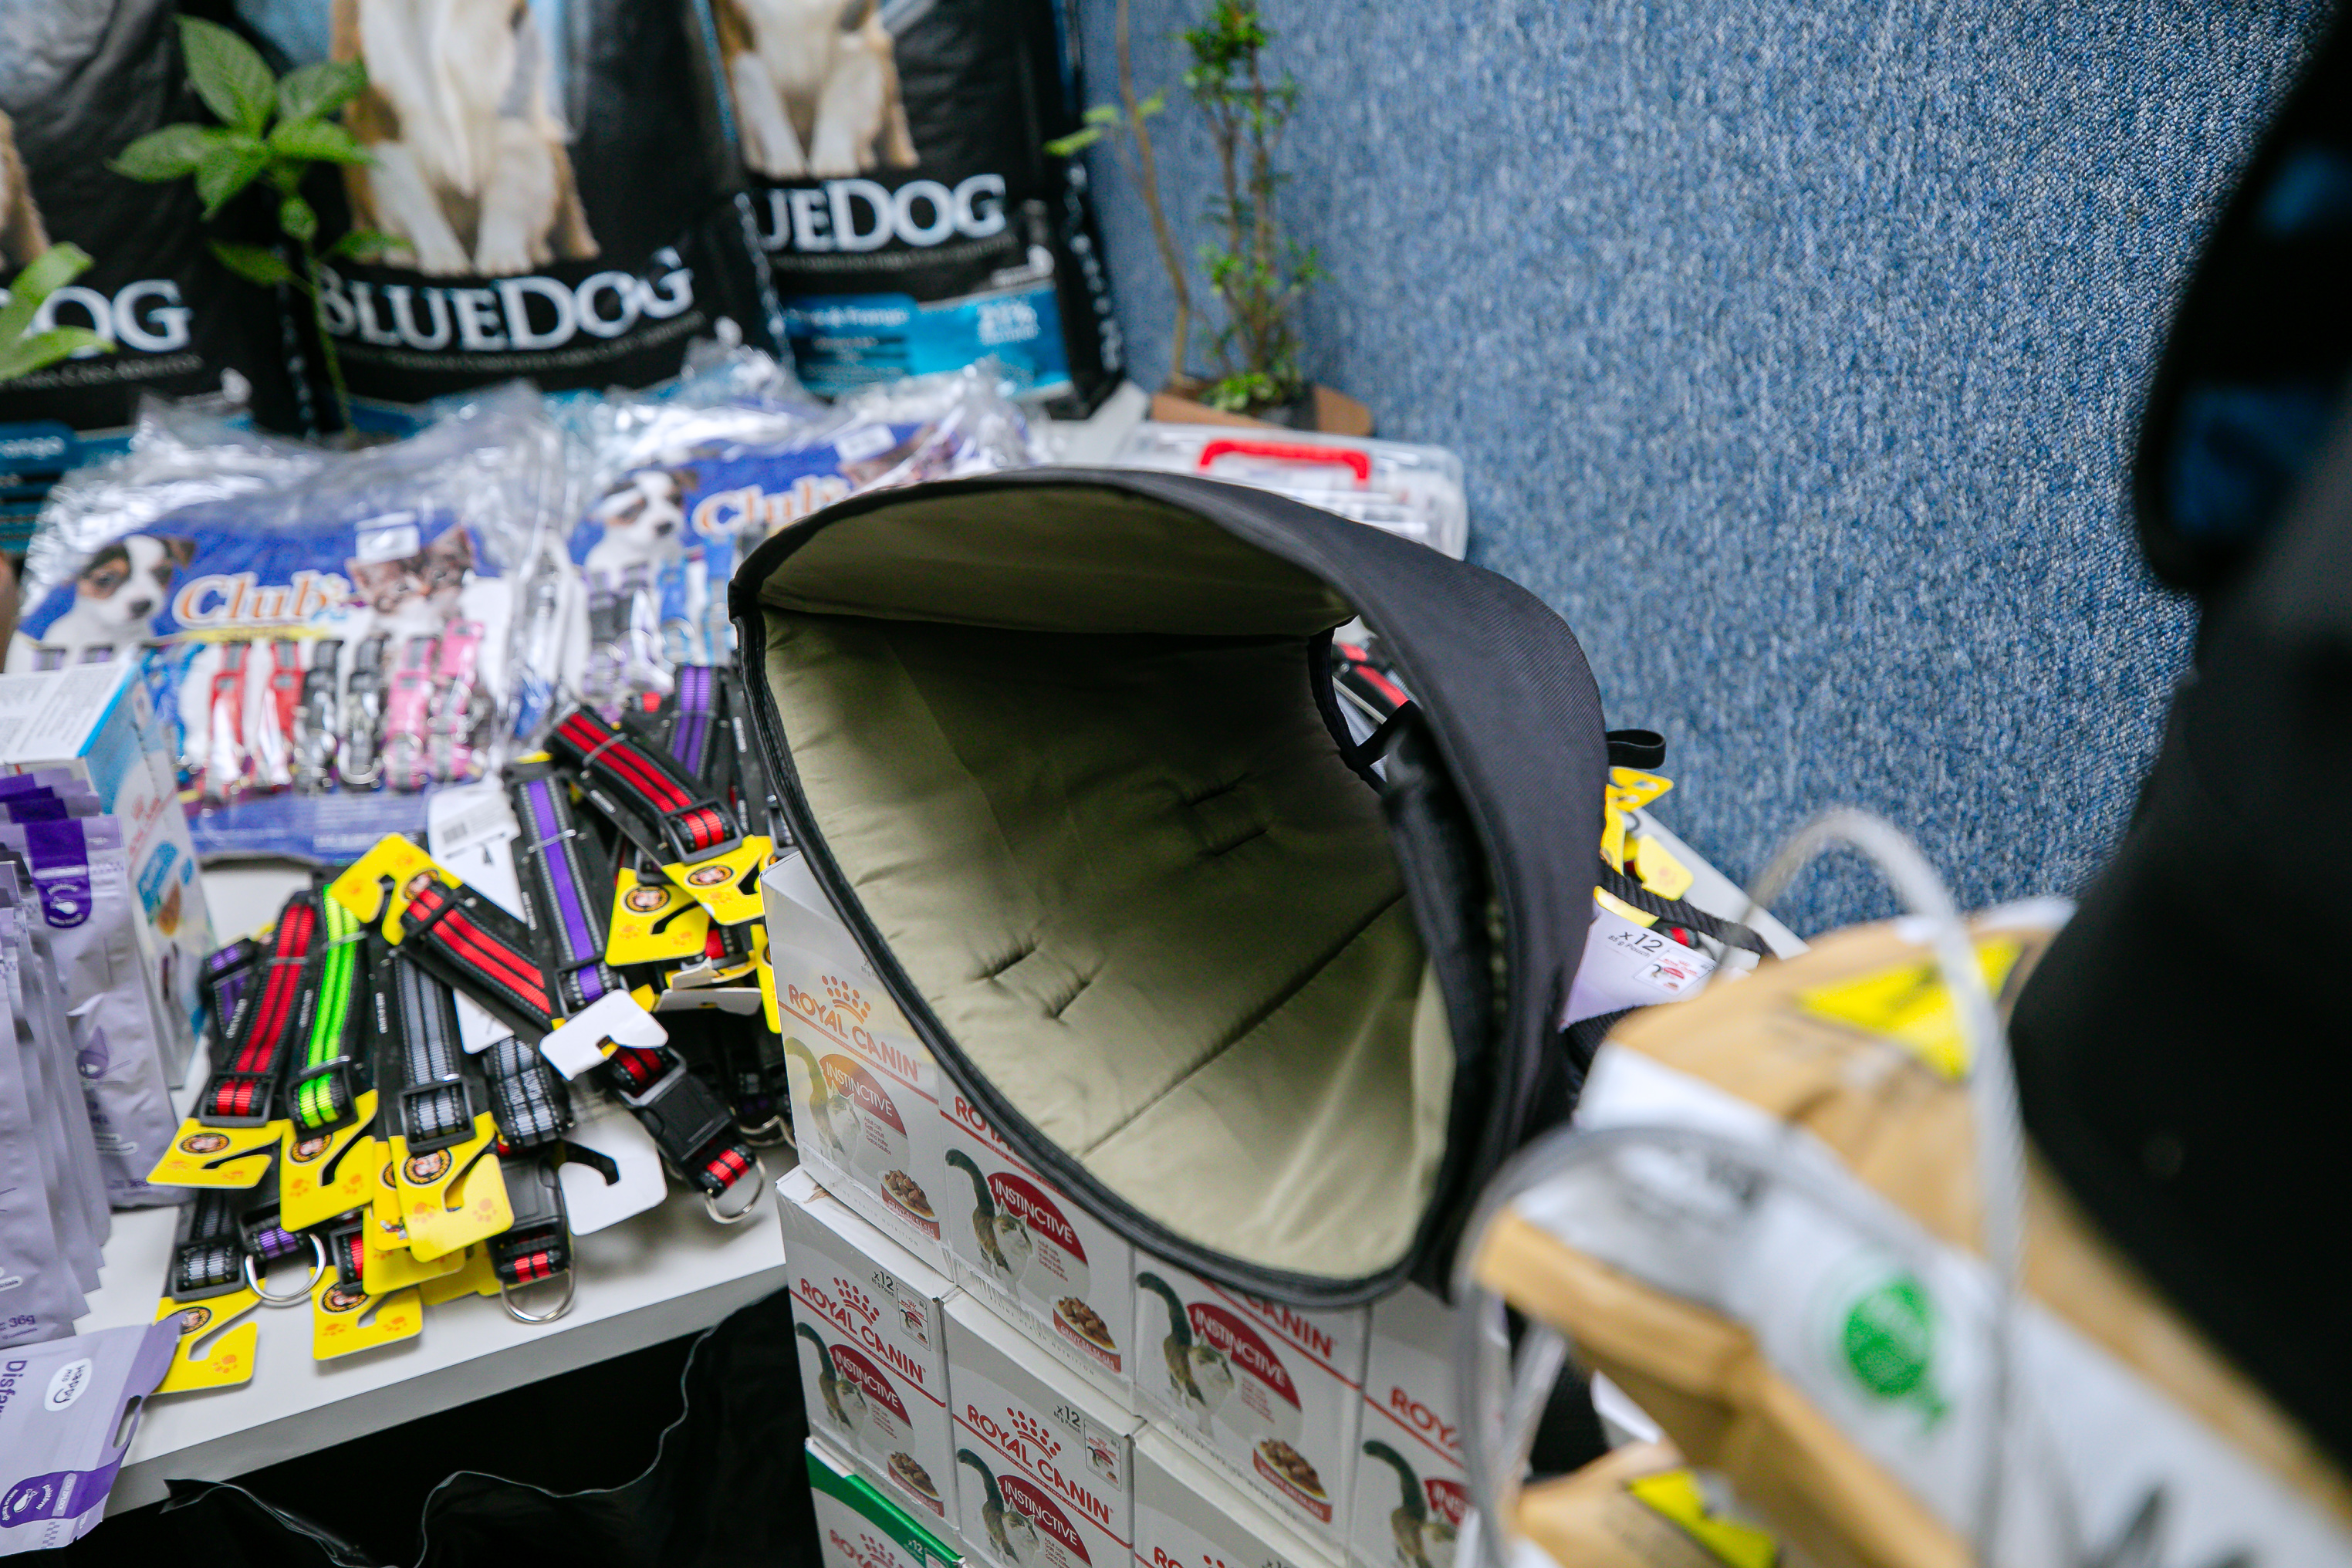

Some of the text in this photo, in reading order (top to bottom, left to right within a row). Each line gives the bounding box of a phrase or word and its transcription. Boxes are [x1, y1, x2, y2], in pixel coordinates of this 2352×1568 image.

[9, 279, 193, 359] OG
[788, 984, 918, 1082] ROYAL CANIN
[826, 1061, 893, 1117] INSTINCTIVE
[995, 1178, 1073, 1245] INSTINCTIVE
[873, 1270, 895, 1292] x12
[800, 1277, 924, 1384] ROYAL CANIN
[1195, 1306, 1287, 1388] INSTINCTIVE
[0, 1360, 28, 1414] Disfa
[834, 1349, 899, 1409] INSTINCTIVE
[1056, 1404, 1081, 1428] x12
[1391, 1386, 1463, 1449] ROY
[967, 1404, 1033, 1468] ROYAL
[1036, 1458, 1110, 1526] CANIN
[1004, 1479, 1077, 1546] INSTINCTIVE
